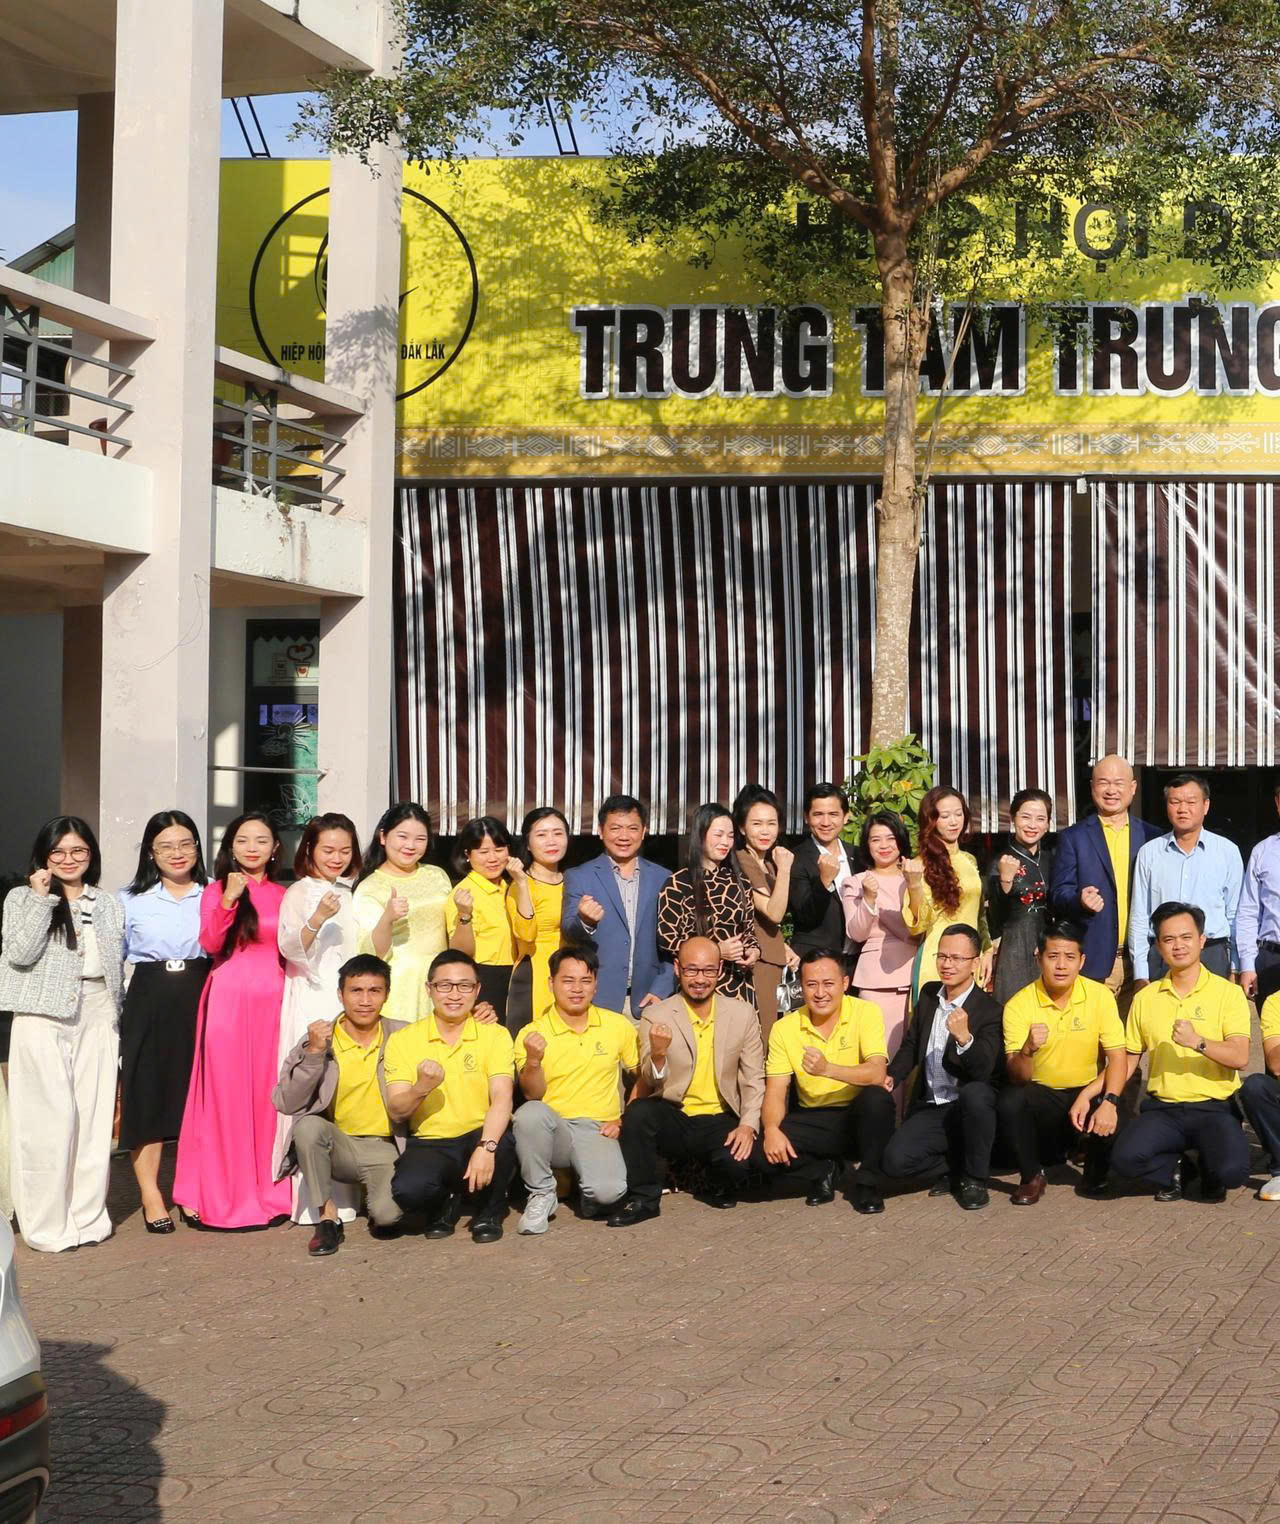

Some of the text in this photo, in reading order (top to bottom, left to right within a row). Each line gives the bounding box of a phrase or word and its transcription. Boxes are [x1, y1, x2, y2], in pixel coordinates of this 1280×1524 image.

[281, 337, 446, 365] HIỆP HỘI ĐẮK LẮK
[575, 303, 828, 394] TRUNG
